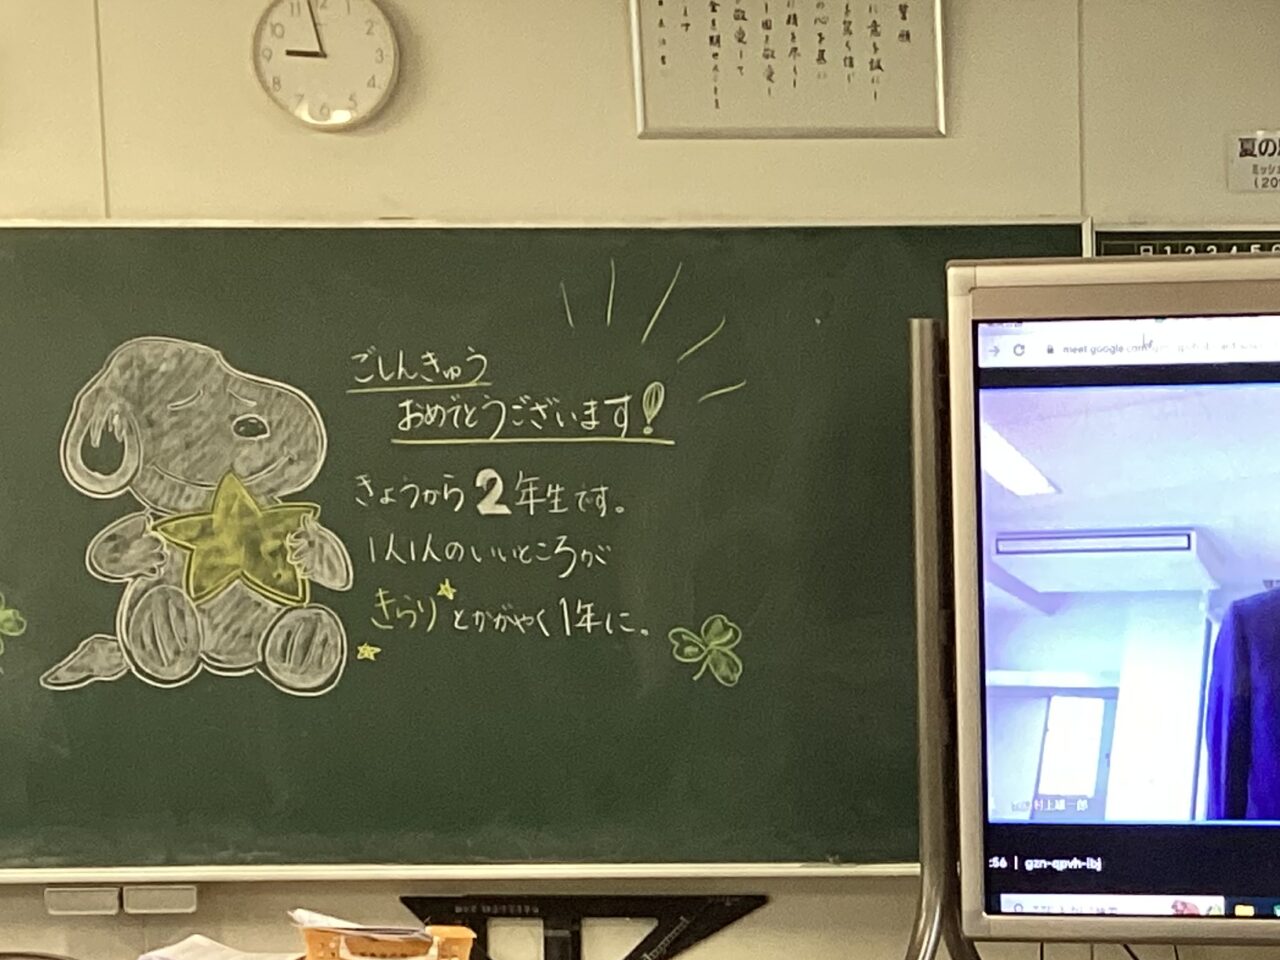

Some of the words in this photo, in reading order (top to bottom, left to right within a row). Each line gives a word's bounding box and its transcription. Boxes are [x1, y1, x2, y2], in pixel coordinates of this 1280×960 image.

[351, 345, 489, 385] ごしんきゅう
[354, 468, 626, 517] きょうから2年生です。
